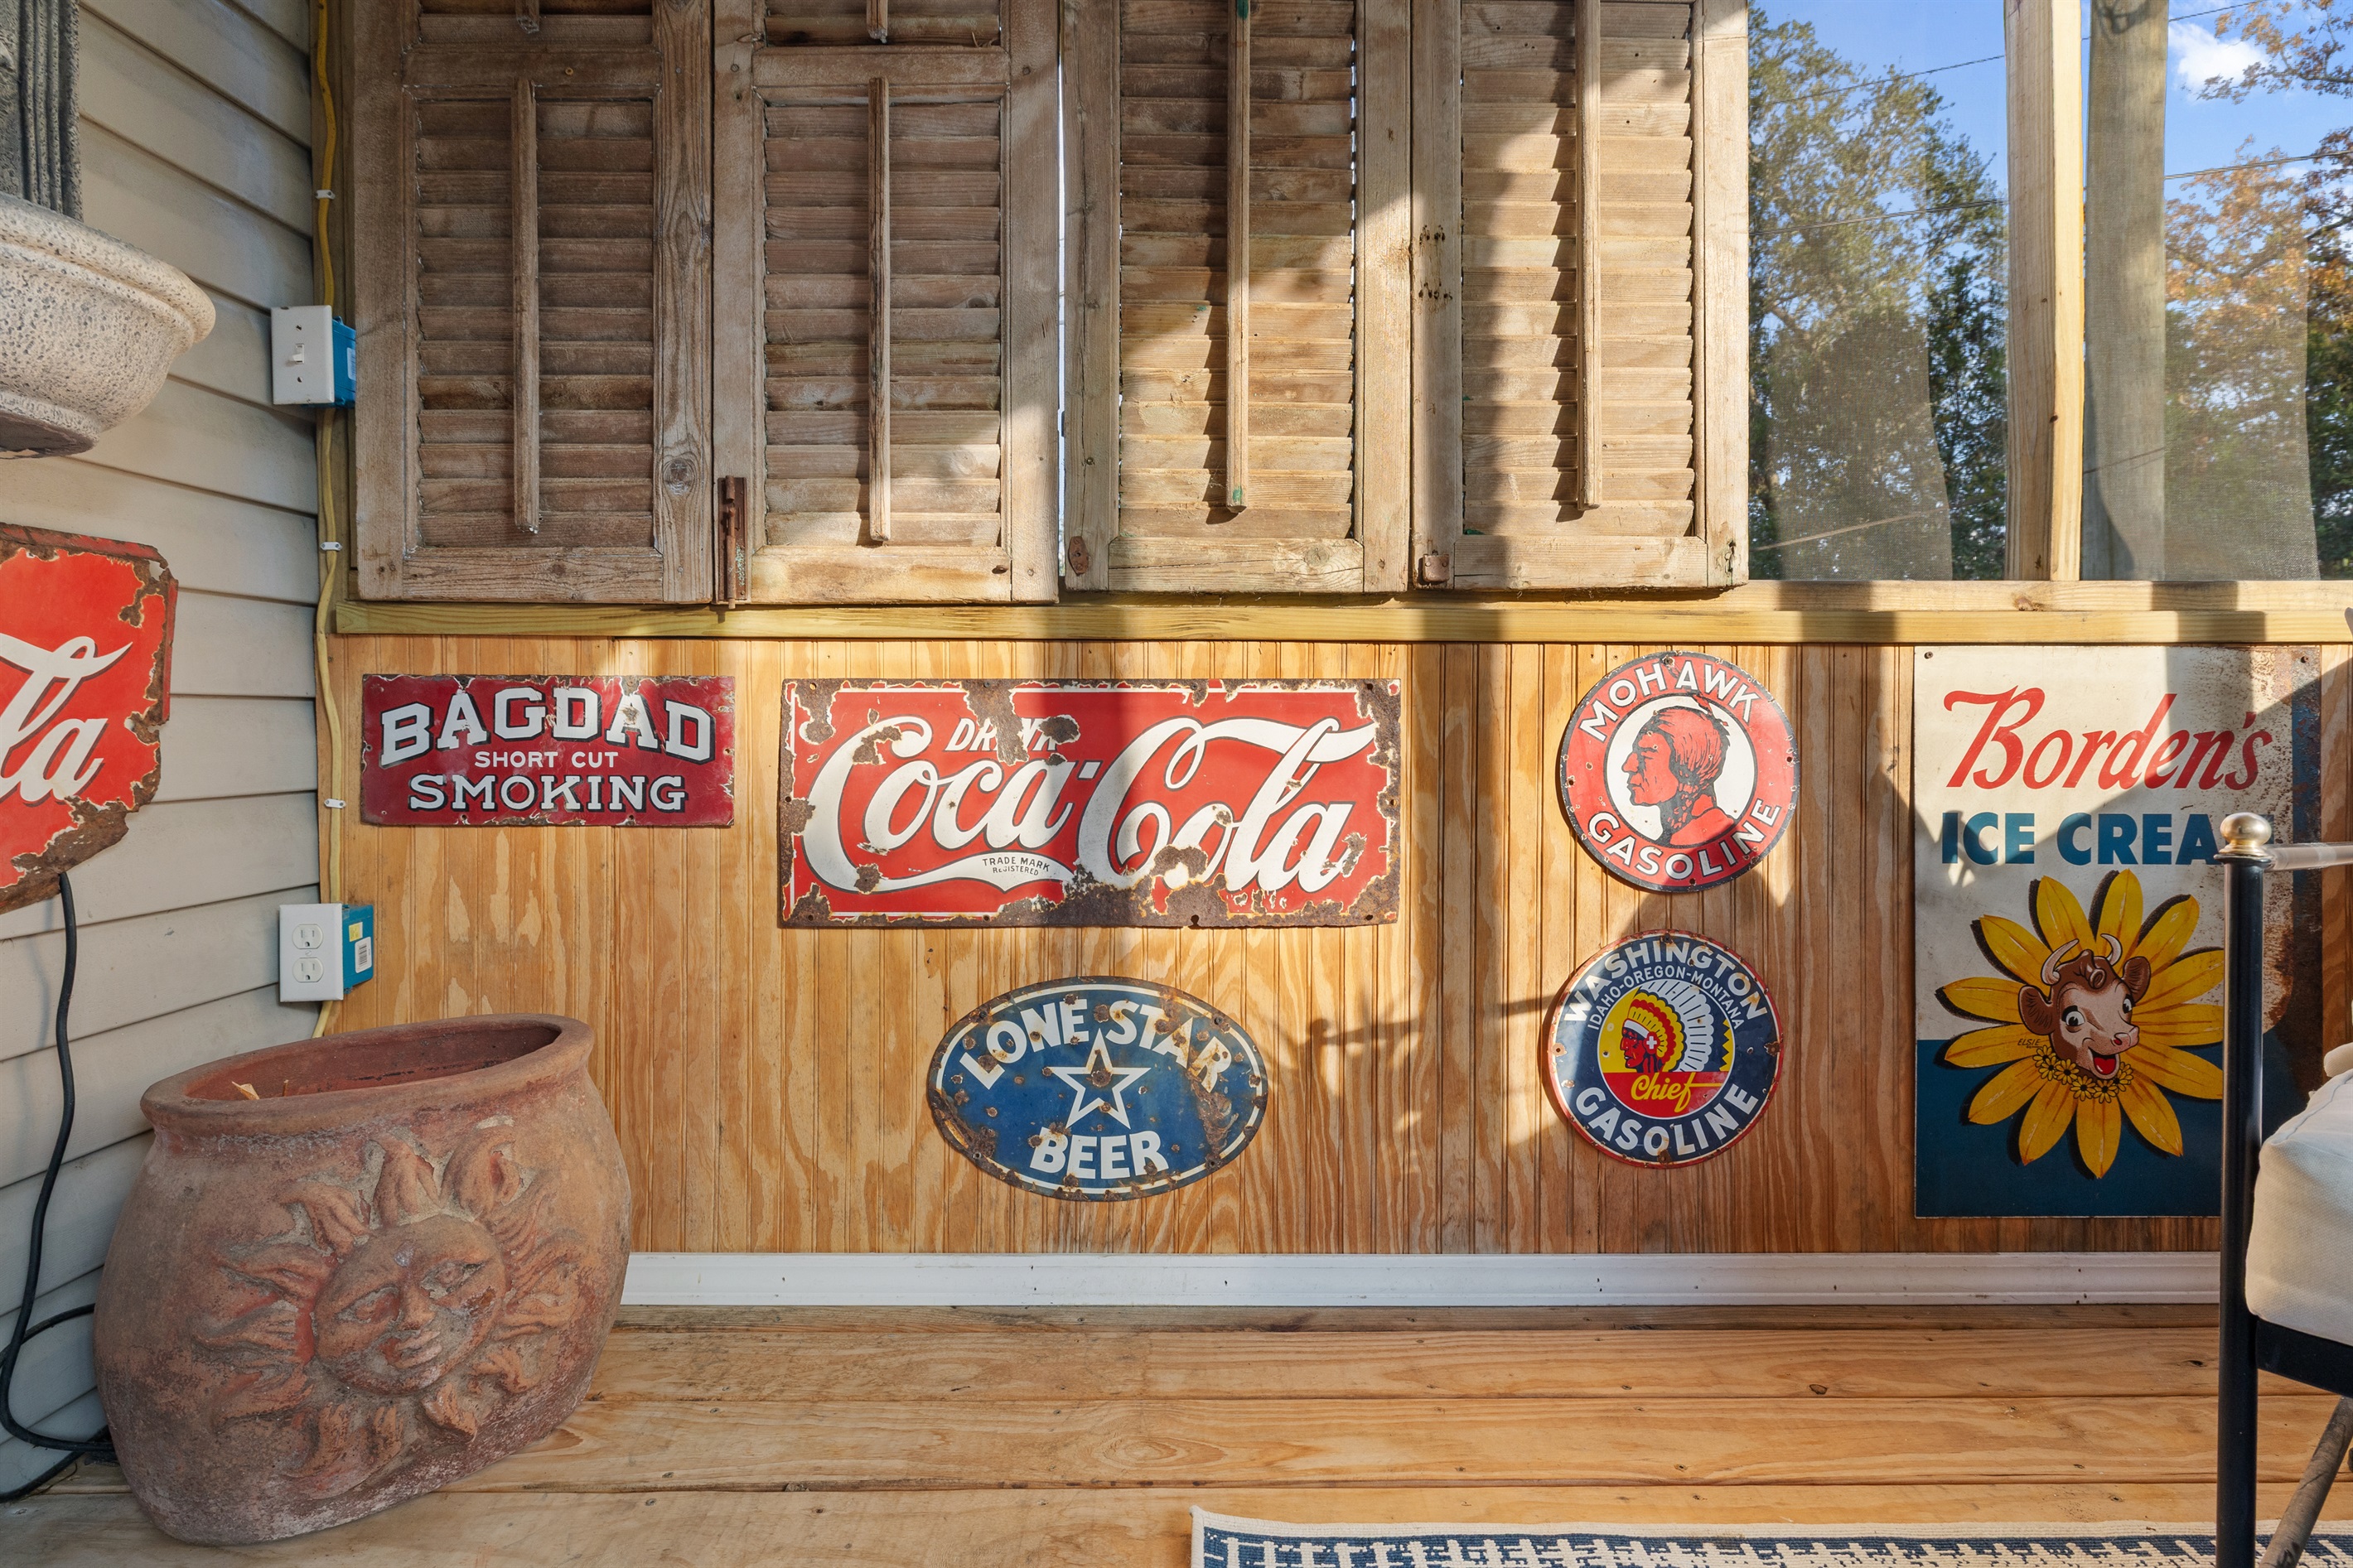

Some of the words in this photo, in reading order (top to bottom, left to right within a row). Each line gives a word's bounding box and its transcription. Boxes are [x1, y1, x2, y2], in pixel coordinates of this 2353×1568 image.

[379, 687, 715, 769] BAGDAD
[1579, 660, 1760, 742] MOHAWK
[1944, 685, 2273, 790] Borden's
[408, 774, 688, 813] SMOKING
[474, 750, 558, 768] SHORT
[571, 750, 618, 768] CUT
[801, 716, 1378, 894] Coca-Cola
[1588, 799, 1780, 880] GASOLINE
[1942, 812, 2035, 866] ICE
[2056, 812, 2274, 866] CREA
[983, 856, 1016, 866] TRADE
[1021, 857, 1051, 871] MARK
[1564, 941, 1767, 1021] WASHINGTON
[959, 999, 1090, 1090] LONE
[1105, 1000, 1232, 1093] STAR
[1576, 1083, 1758, 1156] GASOLINE
[1631, 1072, 1722, 1112] Chief
[1030, 1127, 1168, 1180] BEER
